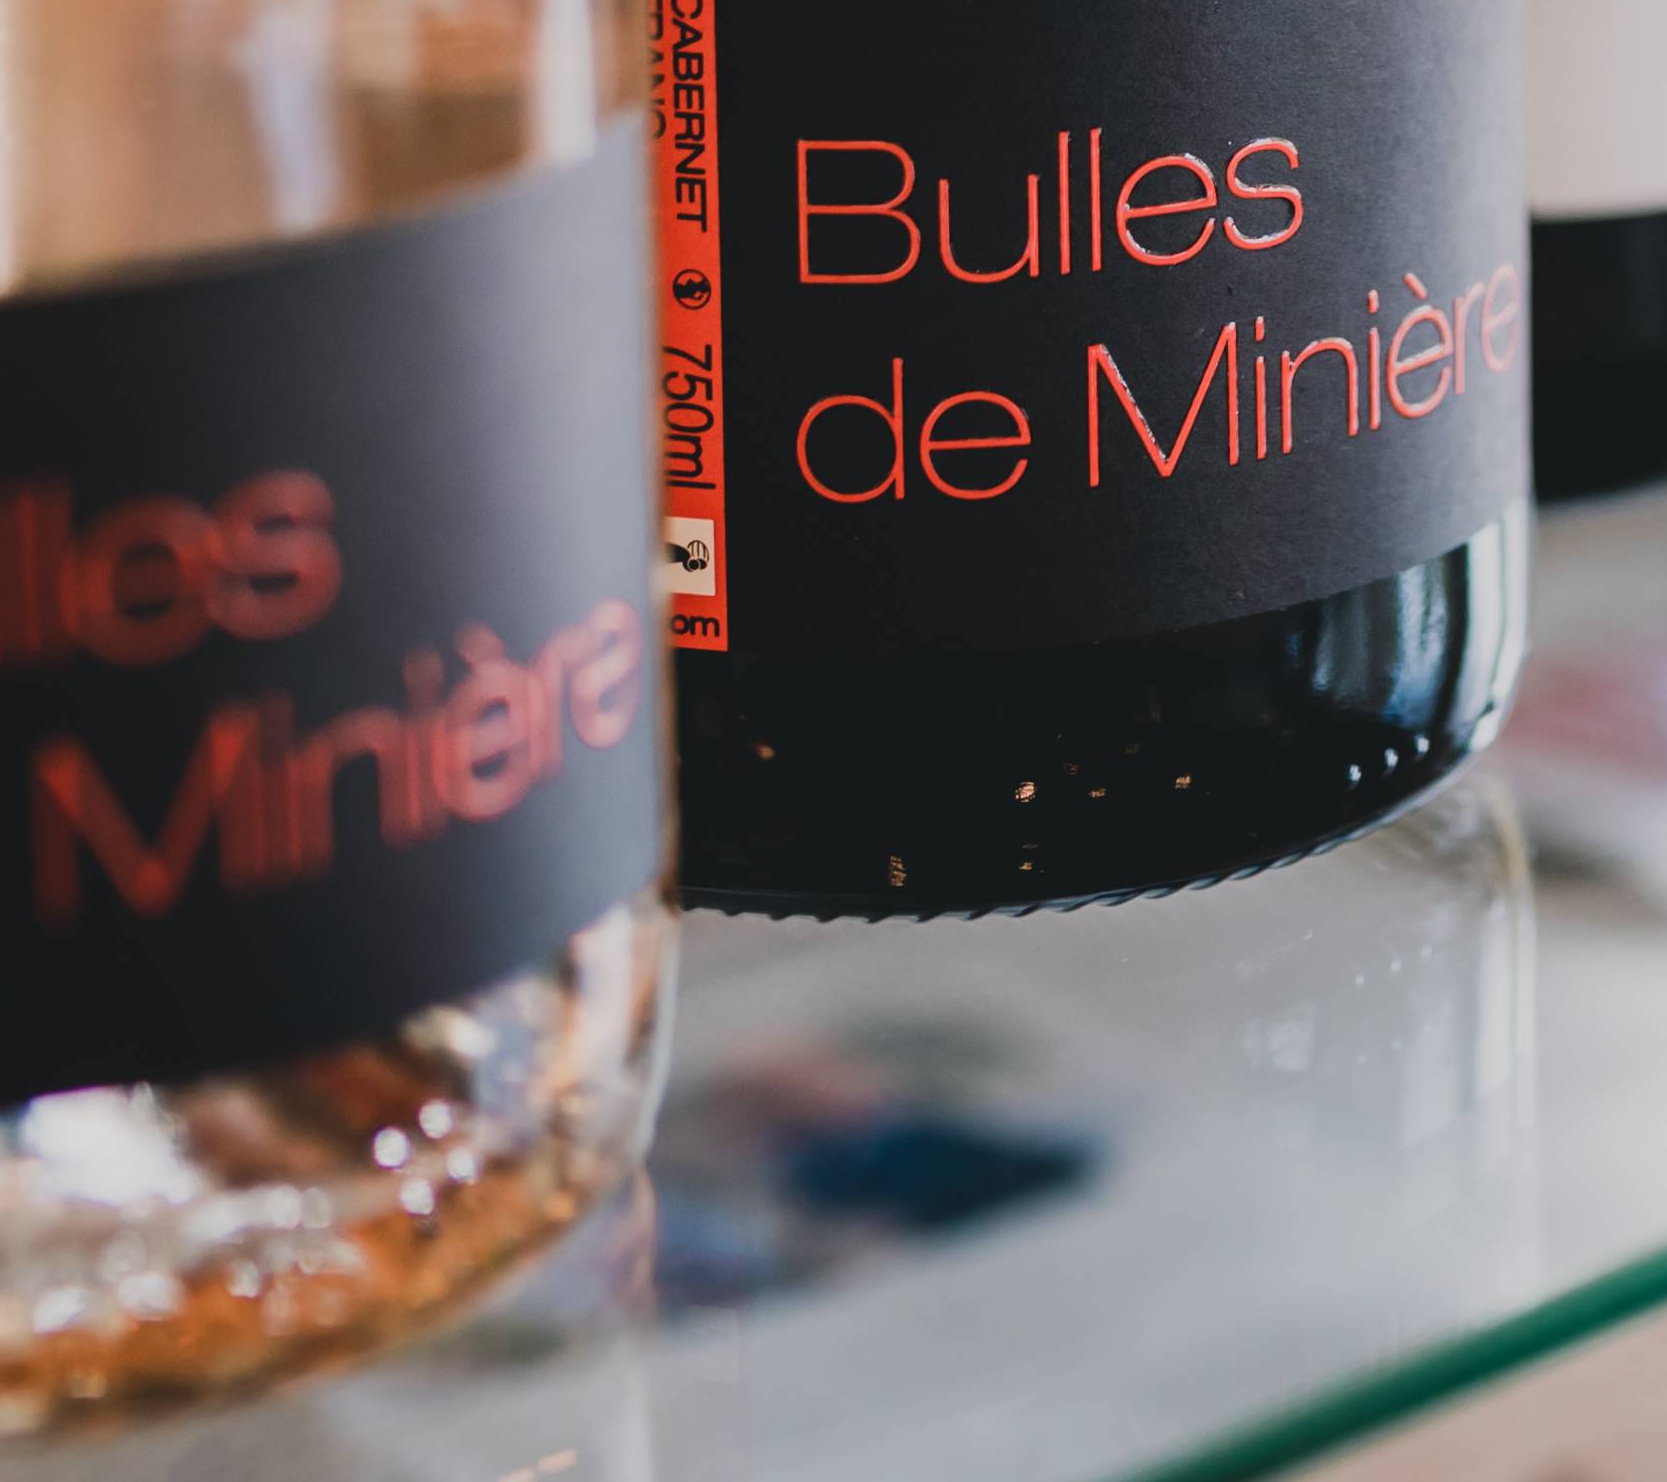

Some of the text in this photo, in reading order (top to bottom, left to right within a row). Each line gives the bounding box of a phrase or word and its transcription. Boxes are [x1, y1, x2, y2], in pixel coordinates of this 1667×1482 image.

[798, 127, 1304, 285] Bulles
[663, 343, 716, 490] 750ml
[796, 263, 1519, 502] de Minière
[27, 598, 640, 928] Minière
